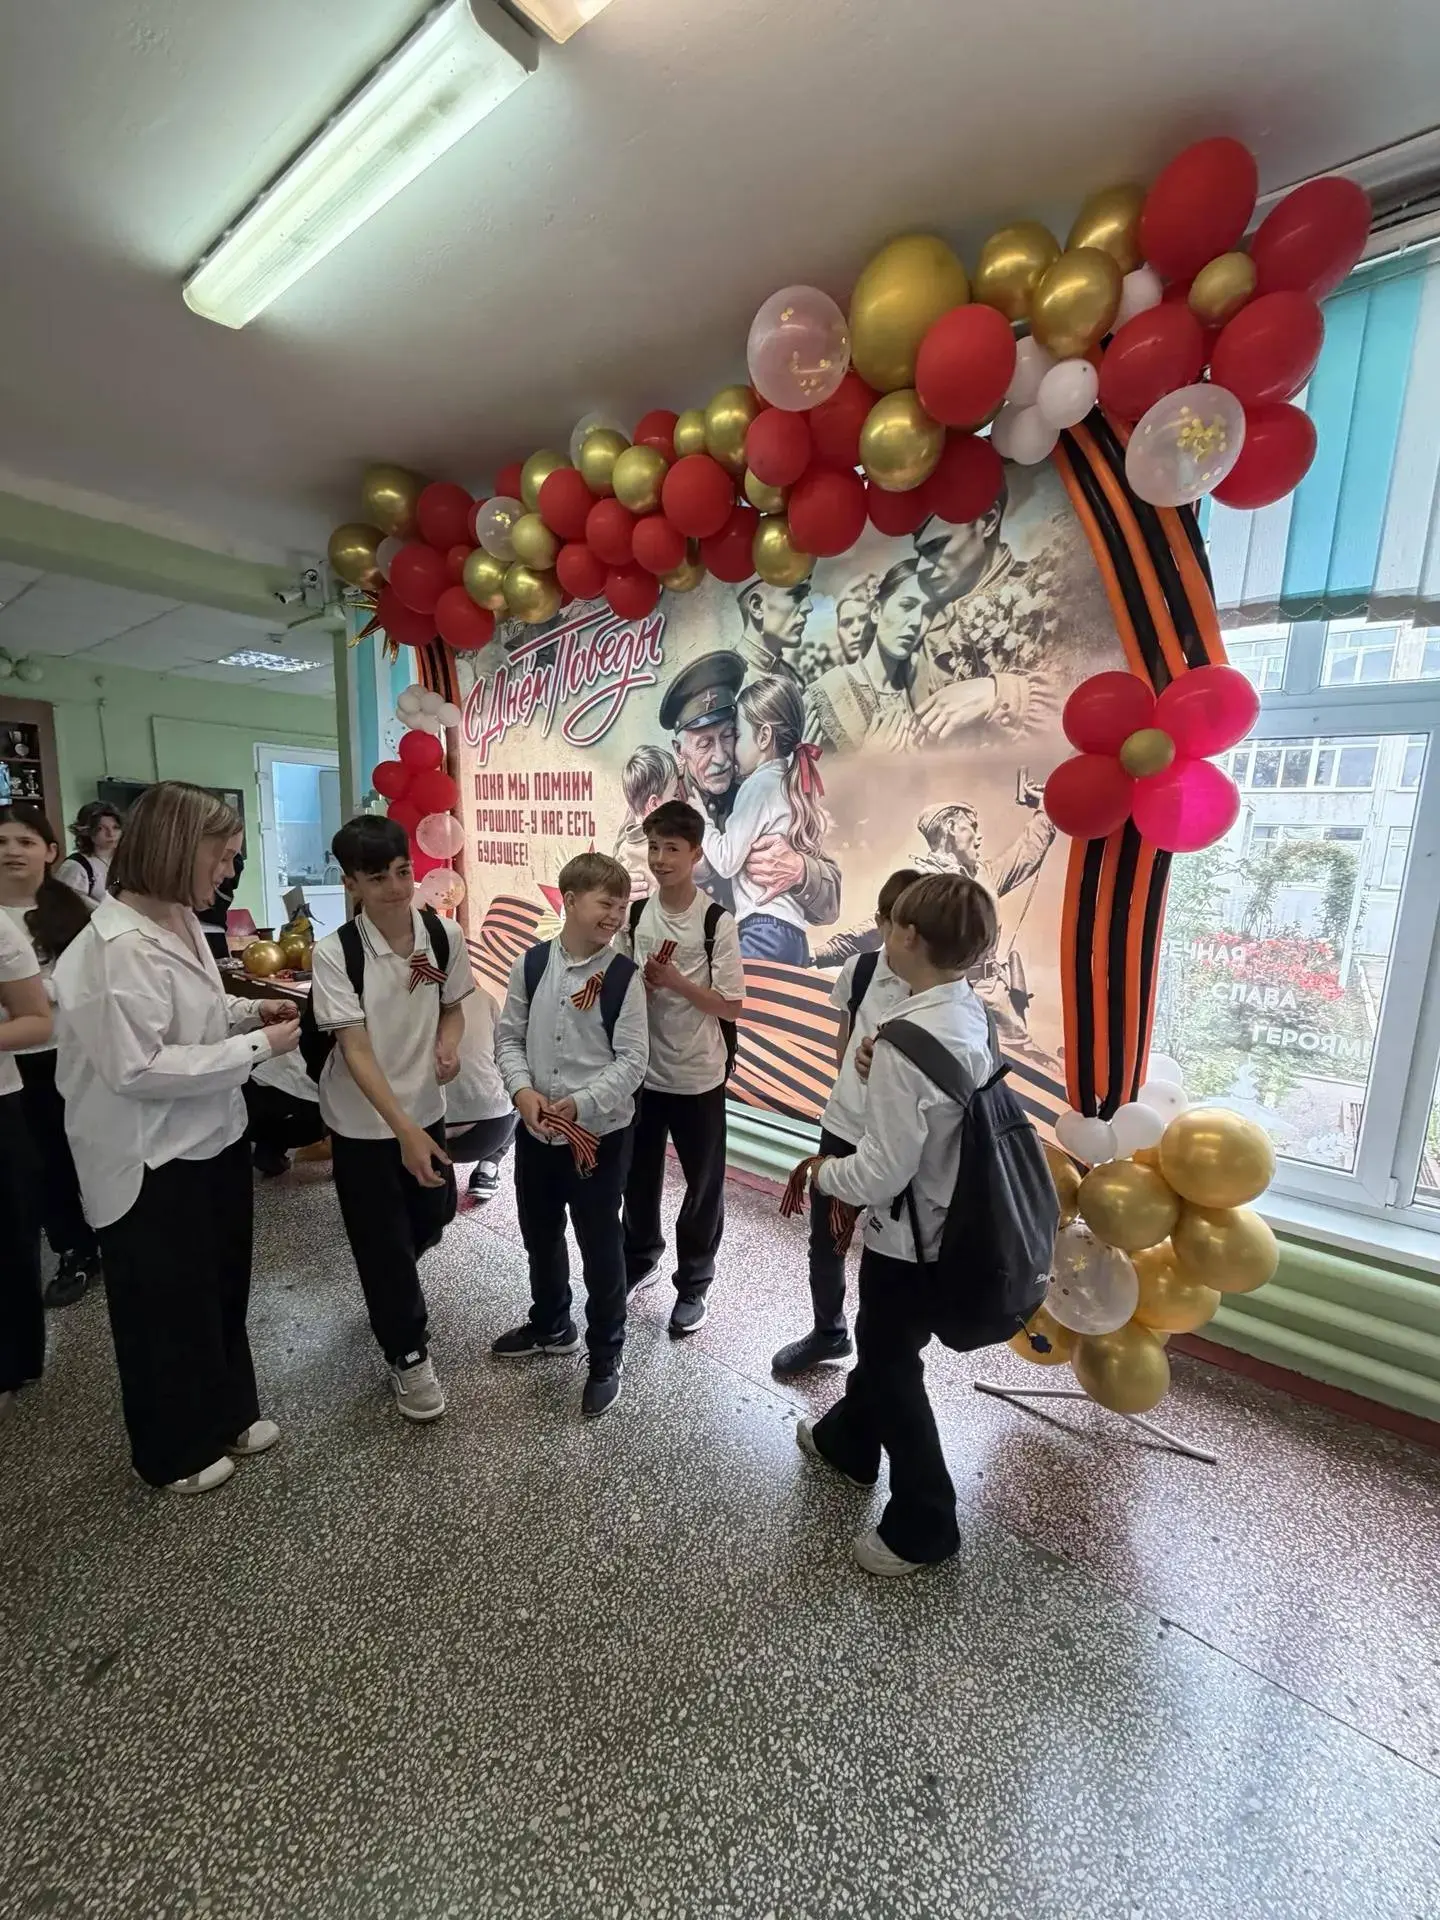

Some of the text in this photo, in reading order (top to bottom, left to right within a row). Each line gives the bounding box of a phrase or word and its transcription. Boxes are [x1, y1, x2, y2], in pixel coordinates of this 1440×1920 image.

[464, 677, 485, 745] С
[508, 605, 665, 746] Победы
[475, 771, 592, 801] ПОКА МЫ ПОМНИМ
[541, 810, 563, 835] НАС
[567, 811, 595, 837] ЕСТЬ
[478, 840, 528, 866] БУДУЩЕЕ!
[1212, 982, 1296, 1009] СЛАВА
